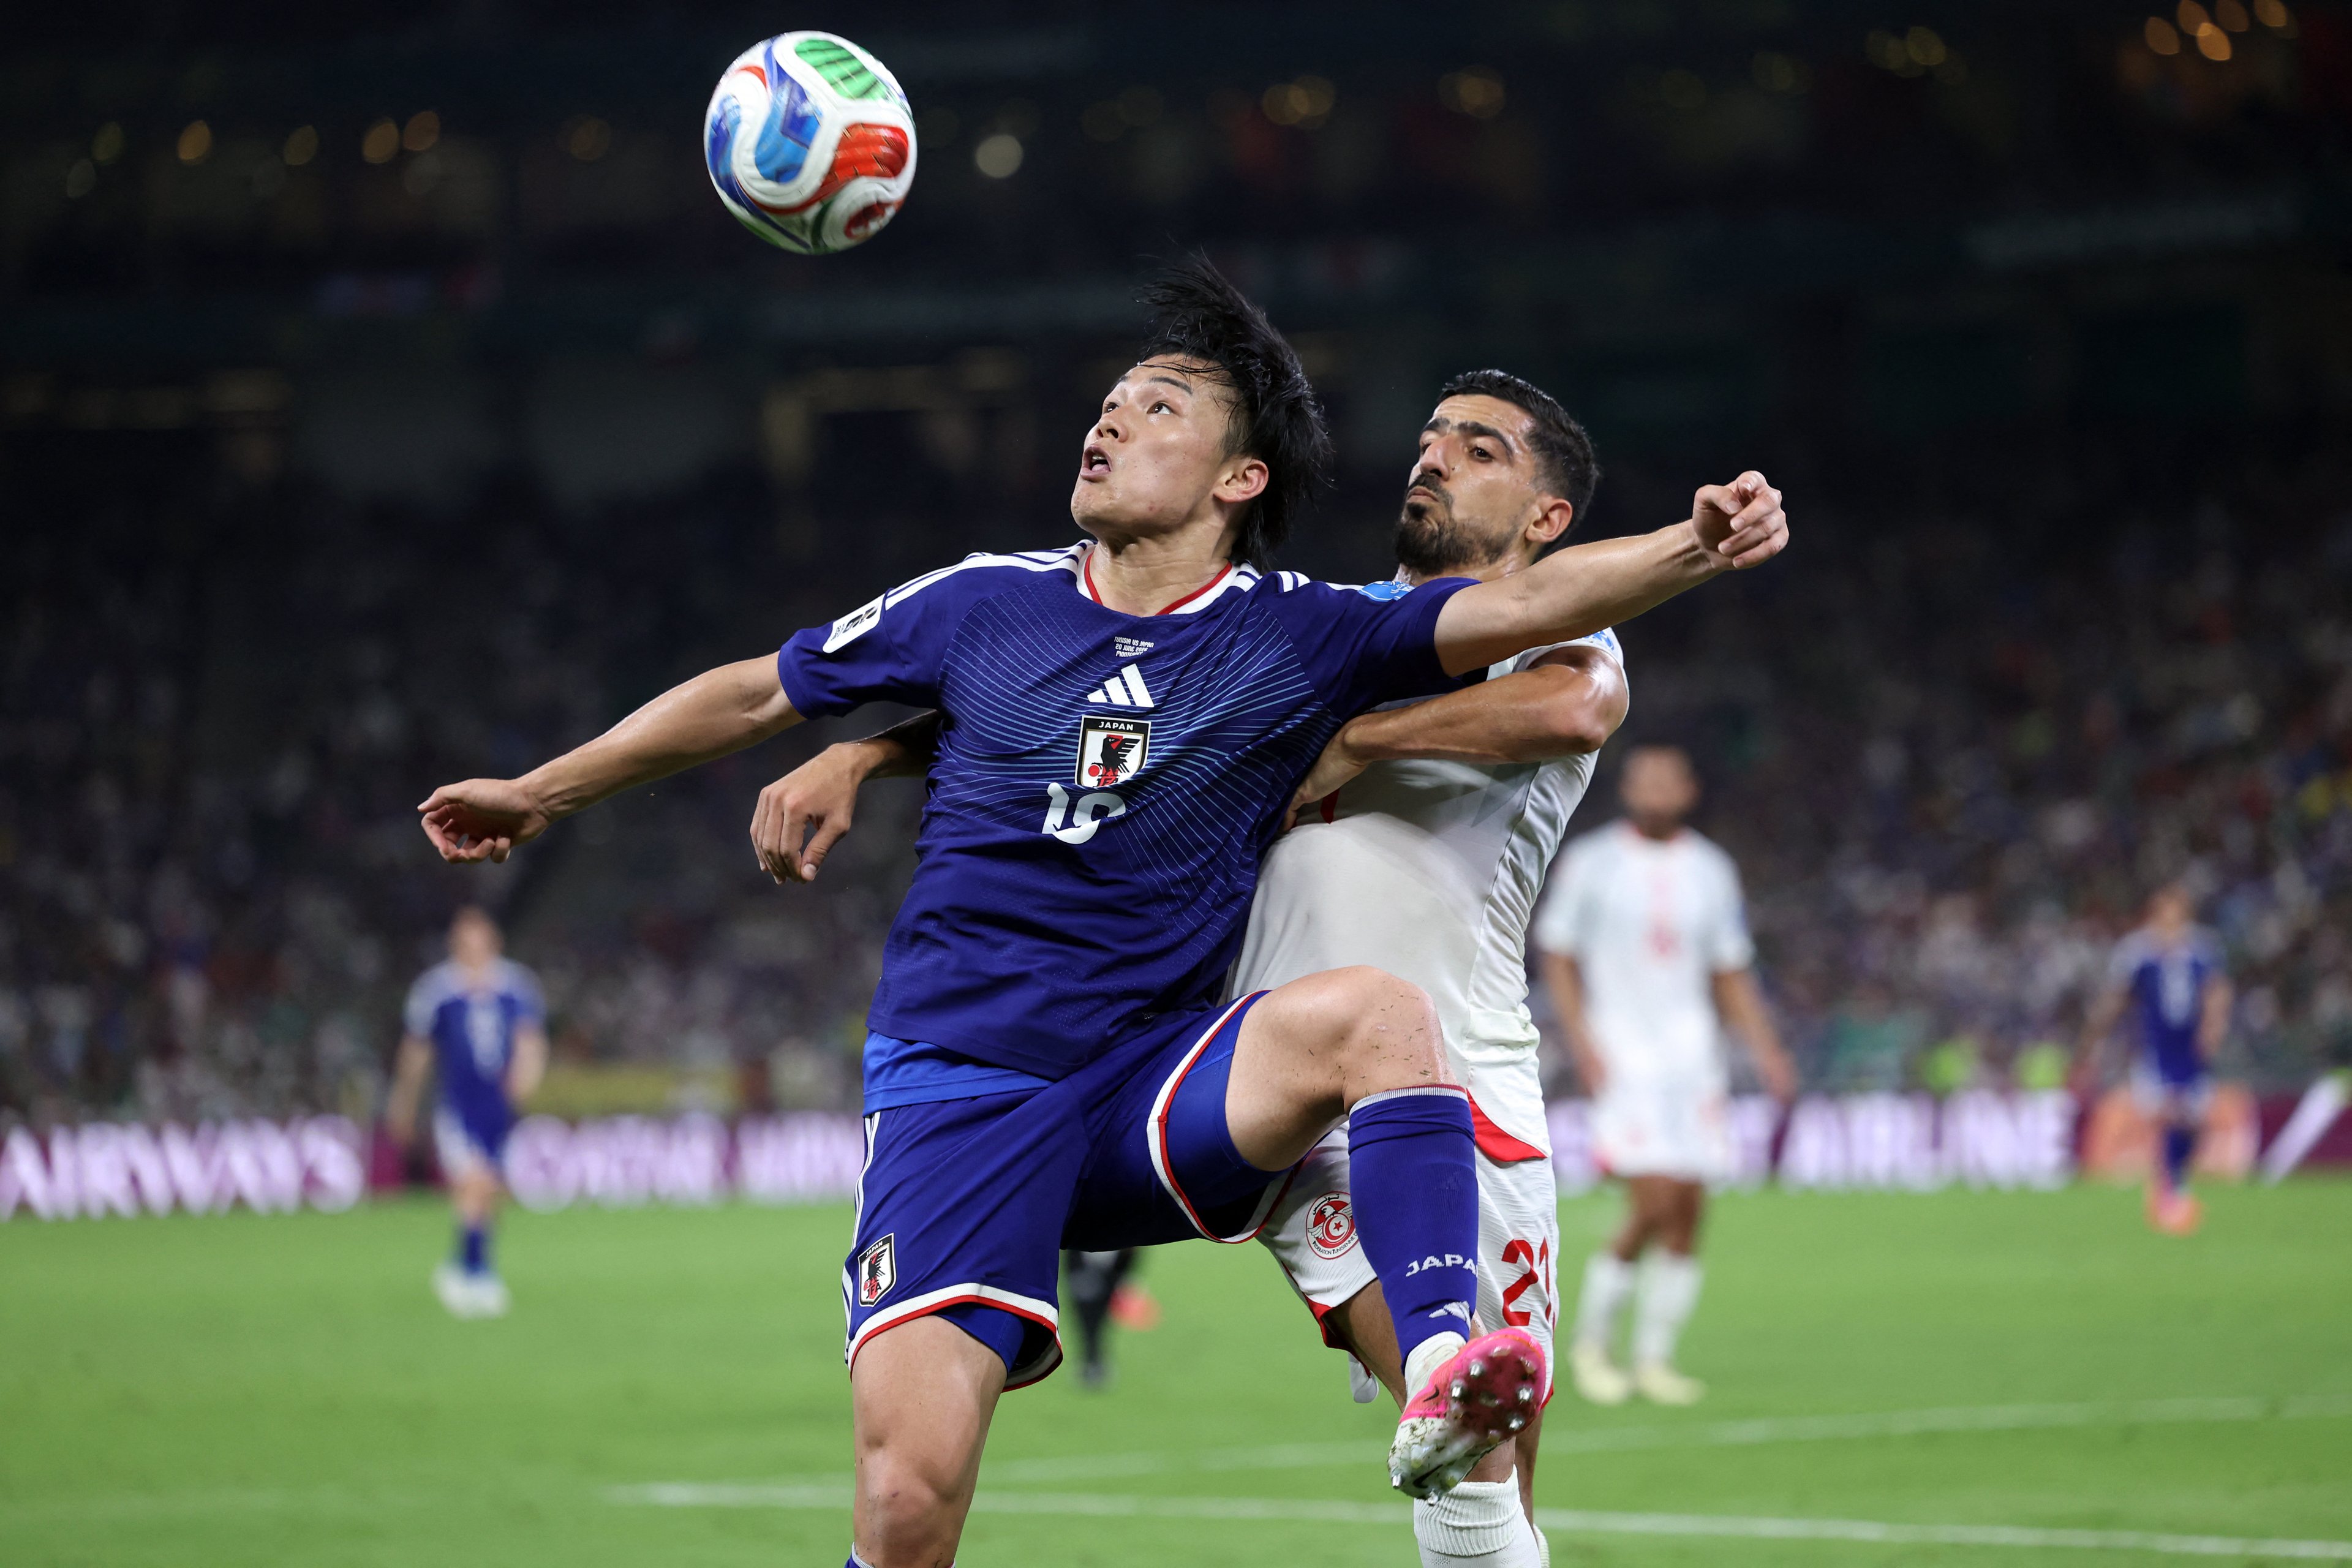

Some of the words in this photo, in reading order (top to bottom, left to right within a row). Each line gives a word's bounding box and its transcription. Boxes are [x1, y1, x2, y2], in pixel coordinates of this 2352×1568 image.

[1114, 636, 1131, 645] TUNISIA
[1098, 722, 1134, 731] JAPAN
[865, 1240, 883, 1257] JAPAN
[1312, 1240, 1332, 1255] FEDERATION
[1332, 1237, 1355, 1254] TUNISIENNE
[1406, 1253, 1478, 1278] JAPA
[1501, 1236, 1552, 1327] 21
